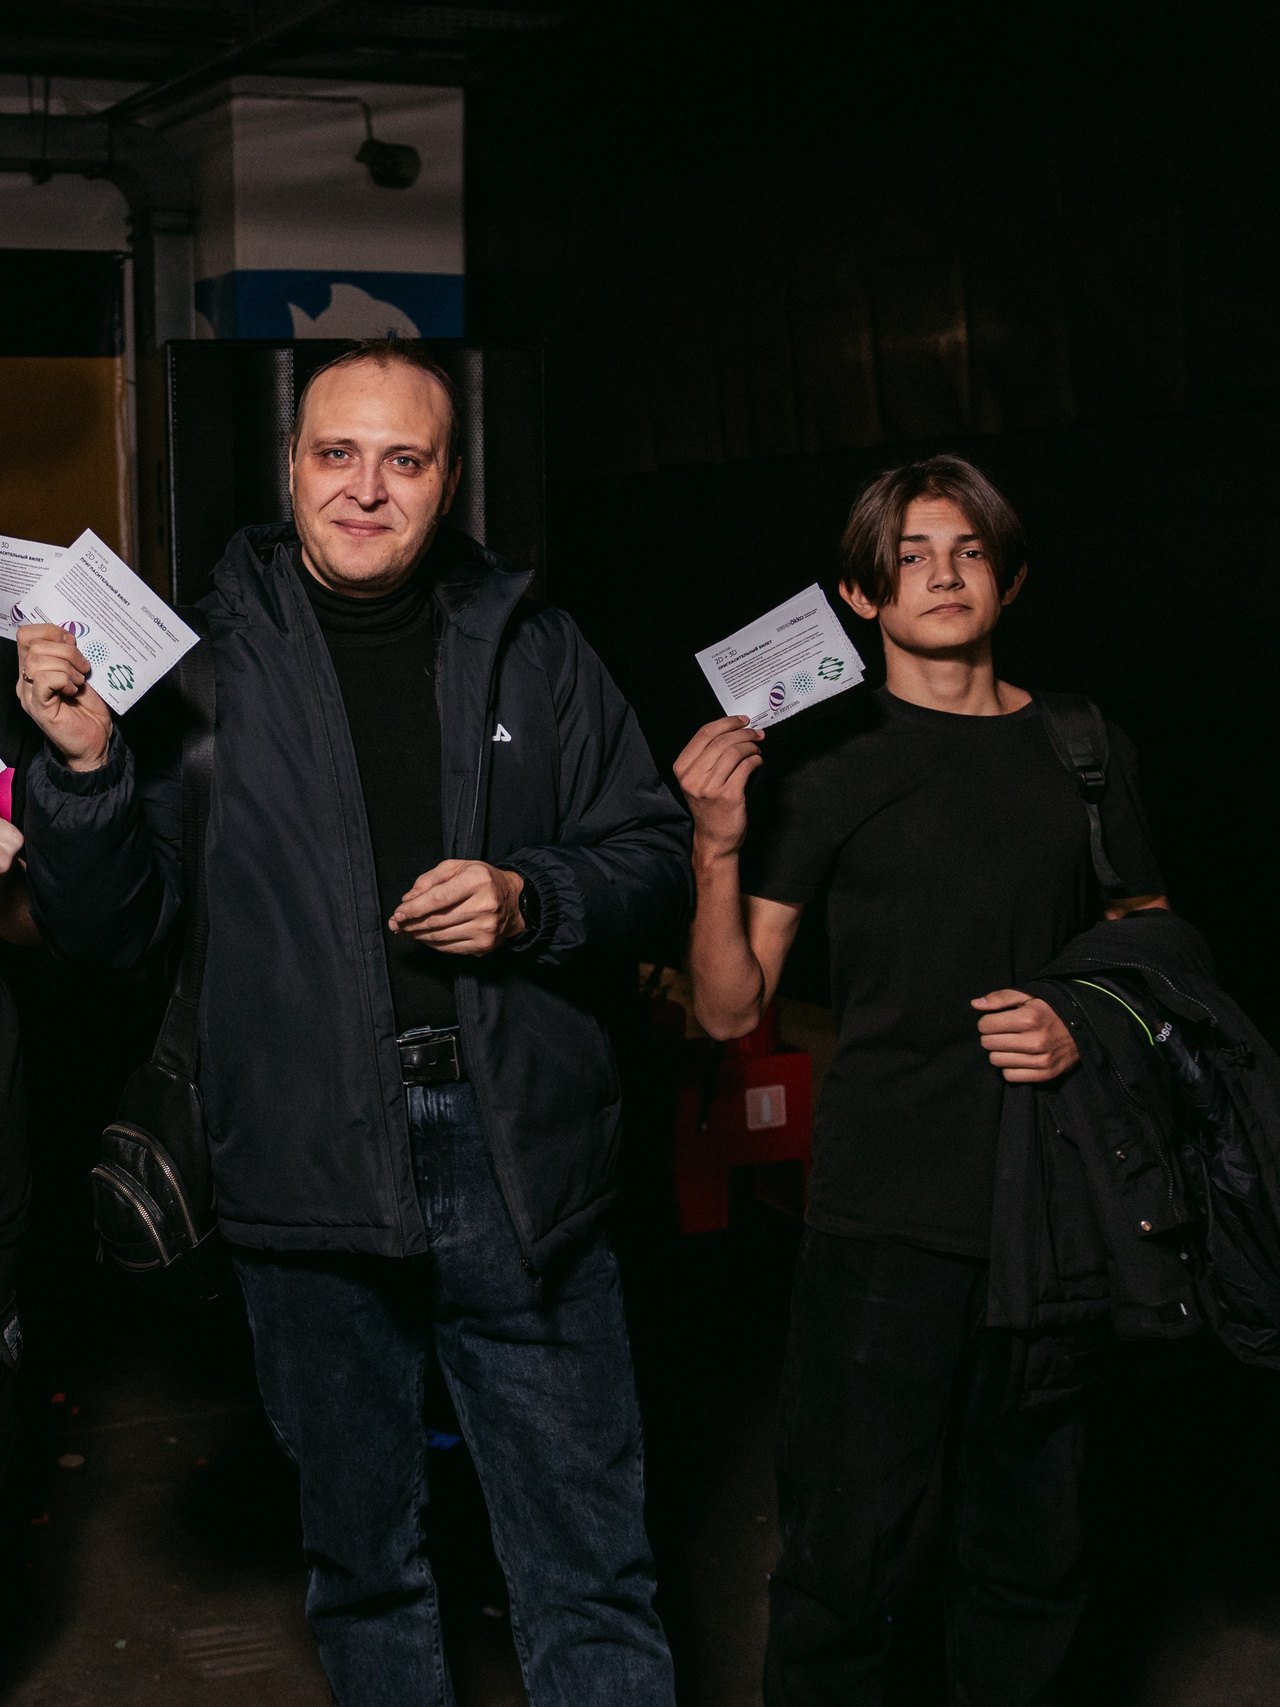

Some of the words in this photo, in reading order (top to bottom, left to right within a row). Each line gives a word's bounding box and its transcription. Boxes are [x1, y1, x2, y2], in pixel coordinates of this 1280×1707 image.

[85, 551, 95, 560] 2D
[97, 563, 107, 573] 3D
[79, 556, 118, 594] ПРИГЛАСИТЕЛЬНЫЙ
[117, 593, 130, 606] БИЛЕТ
[714, 656, 723, 664] 2D
[728, 649, 737, 657] 3D
[717, 646, 758, 670] ПРИГЛАСИТЕЛЬНЫЙ
[758, 639, 772, 648] БИЛЕТ
